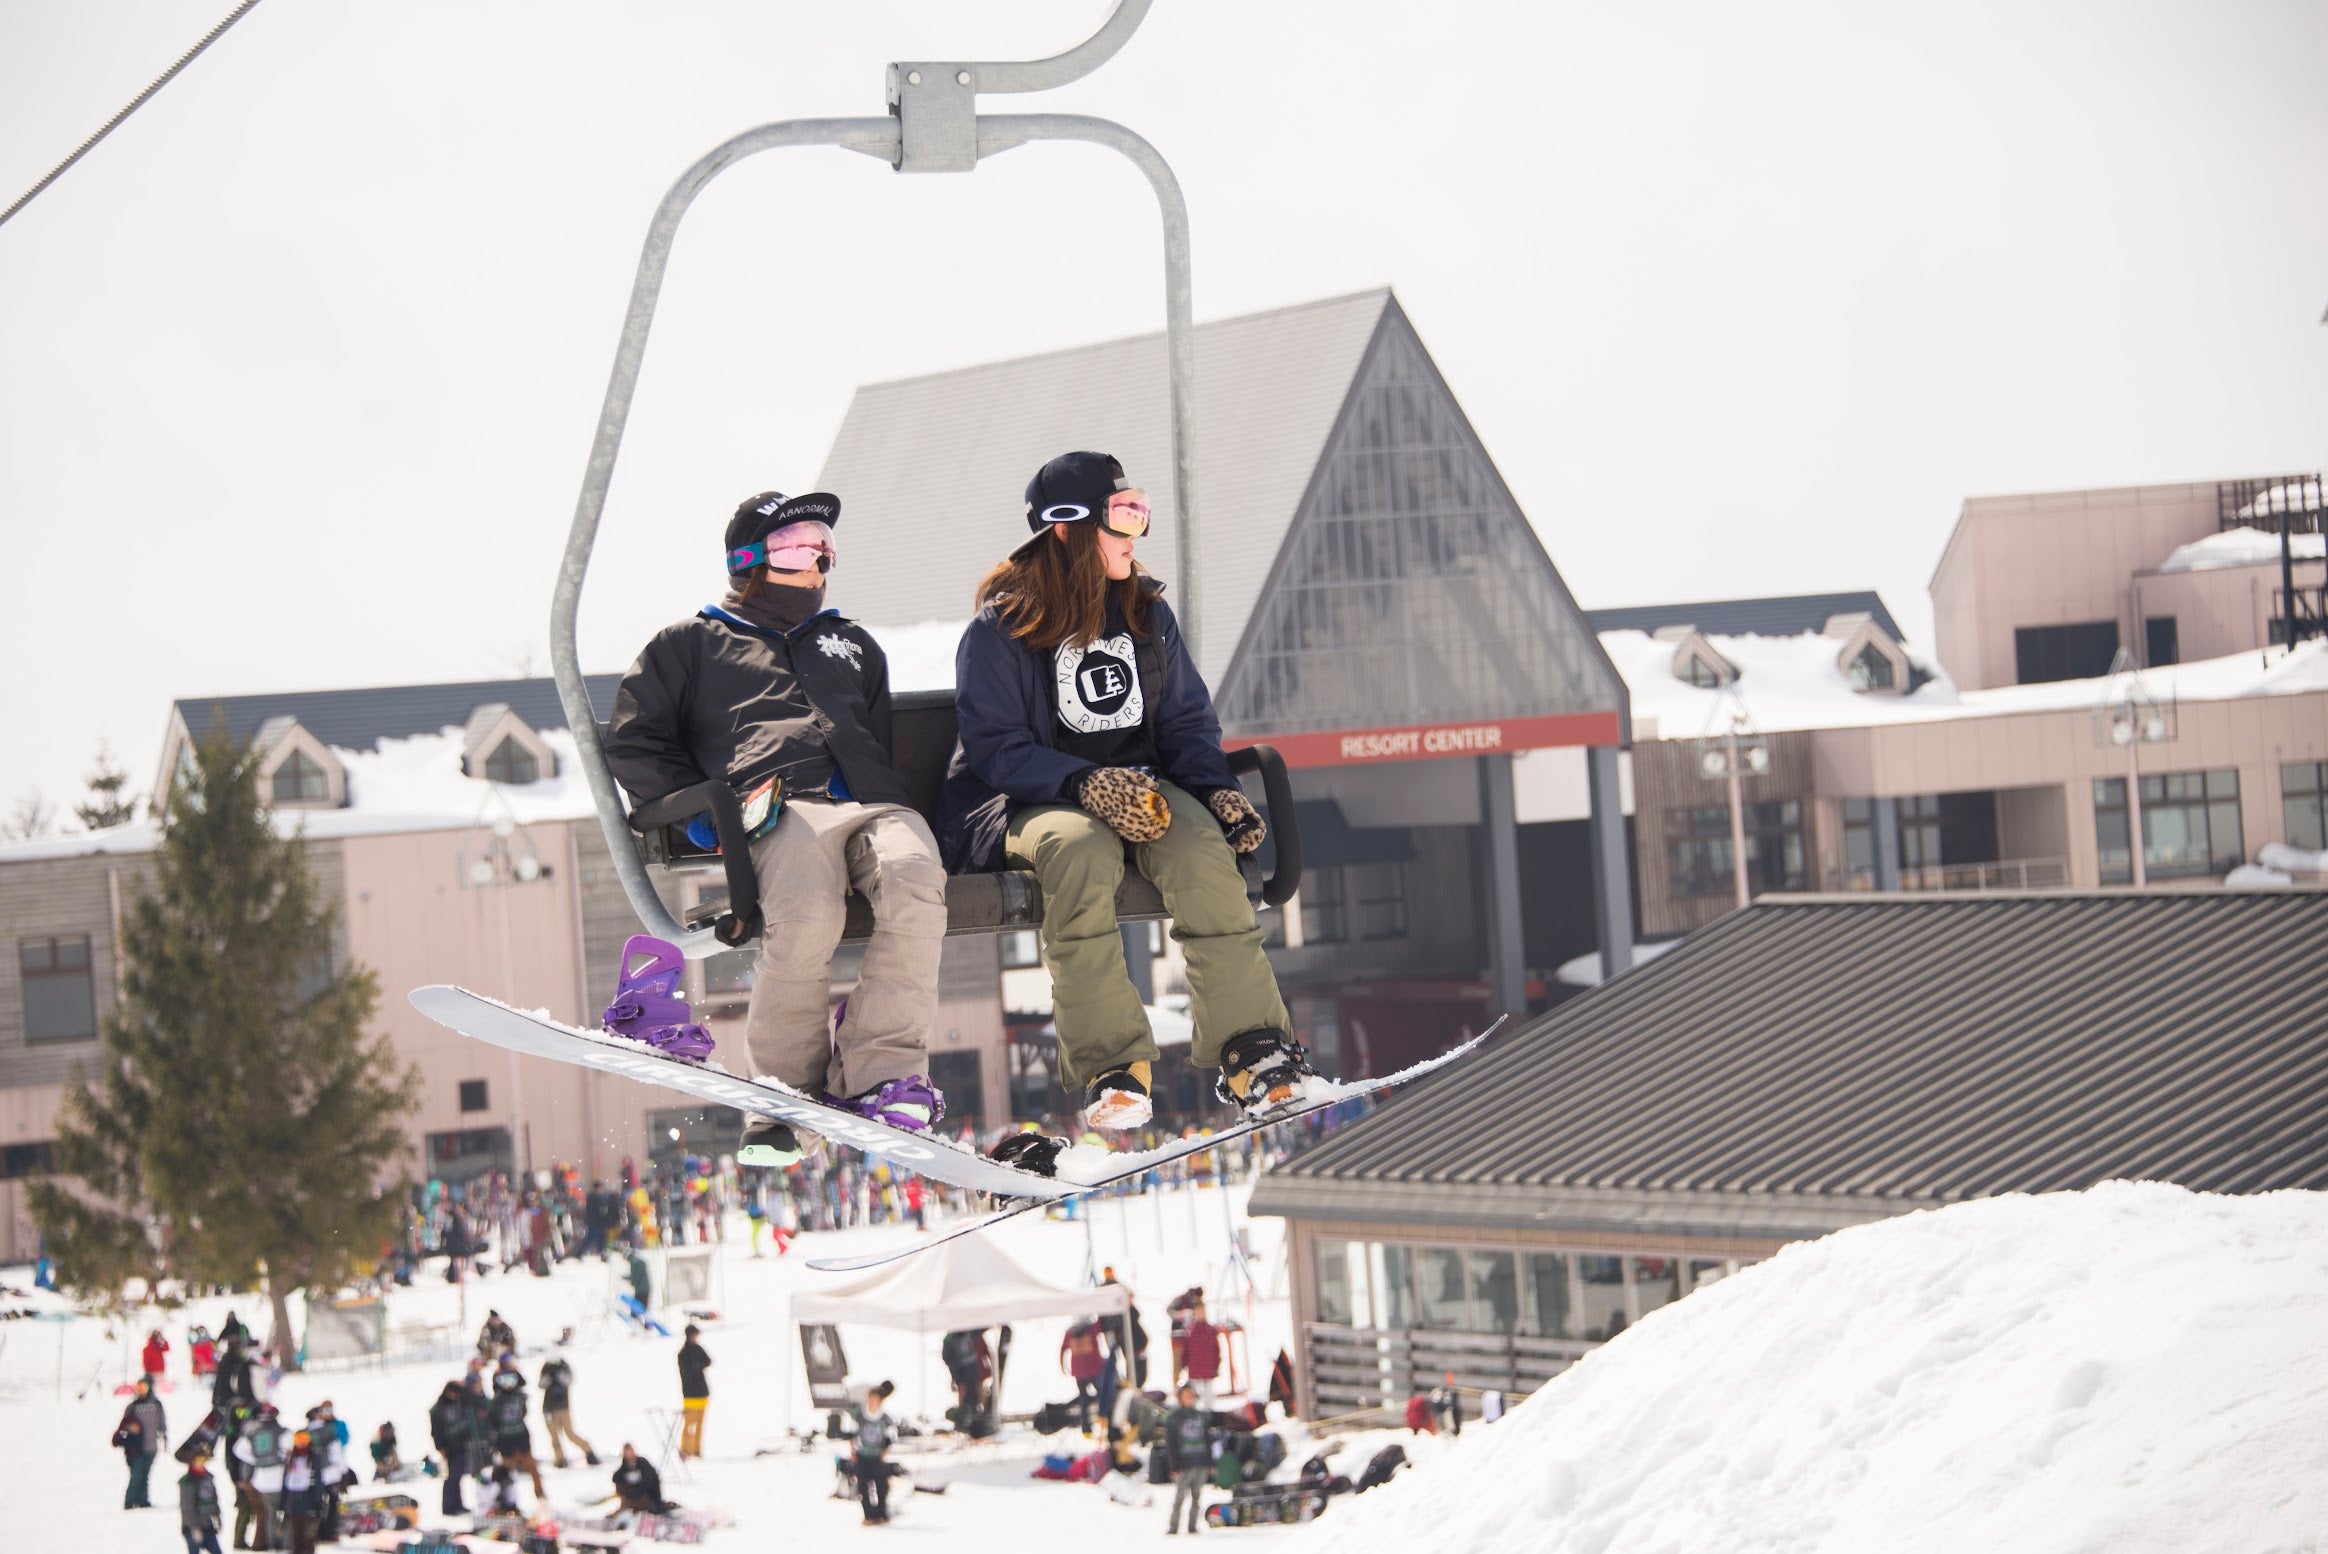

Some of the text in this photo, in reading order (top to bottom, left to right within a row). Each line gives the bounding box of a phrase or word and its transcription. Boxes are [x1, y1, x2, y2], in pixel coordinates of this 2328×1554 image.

[778, 504, 834, 521] ABNORMAL
[1078, 697, 1142, 731] RIDERS
[1340, 726, 1502, 758] RESORT CENTER
